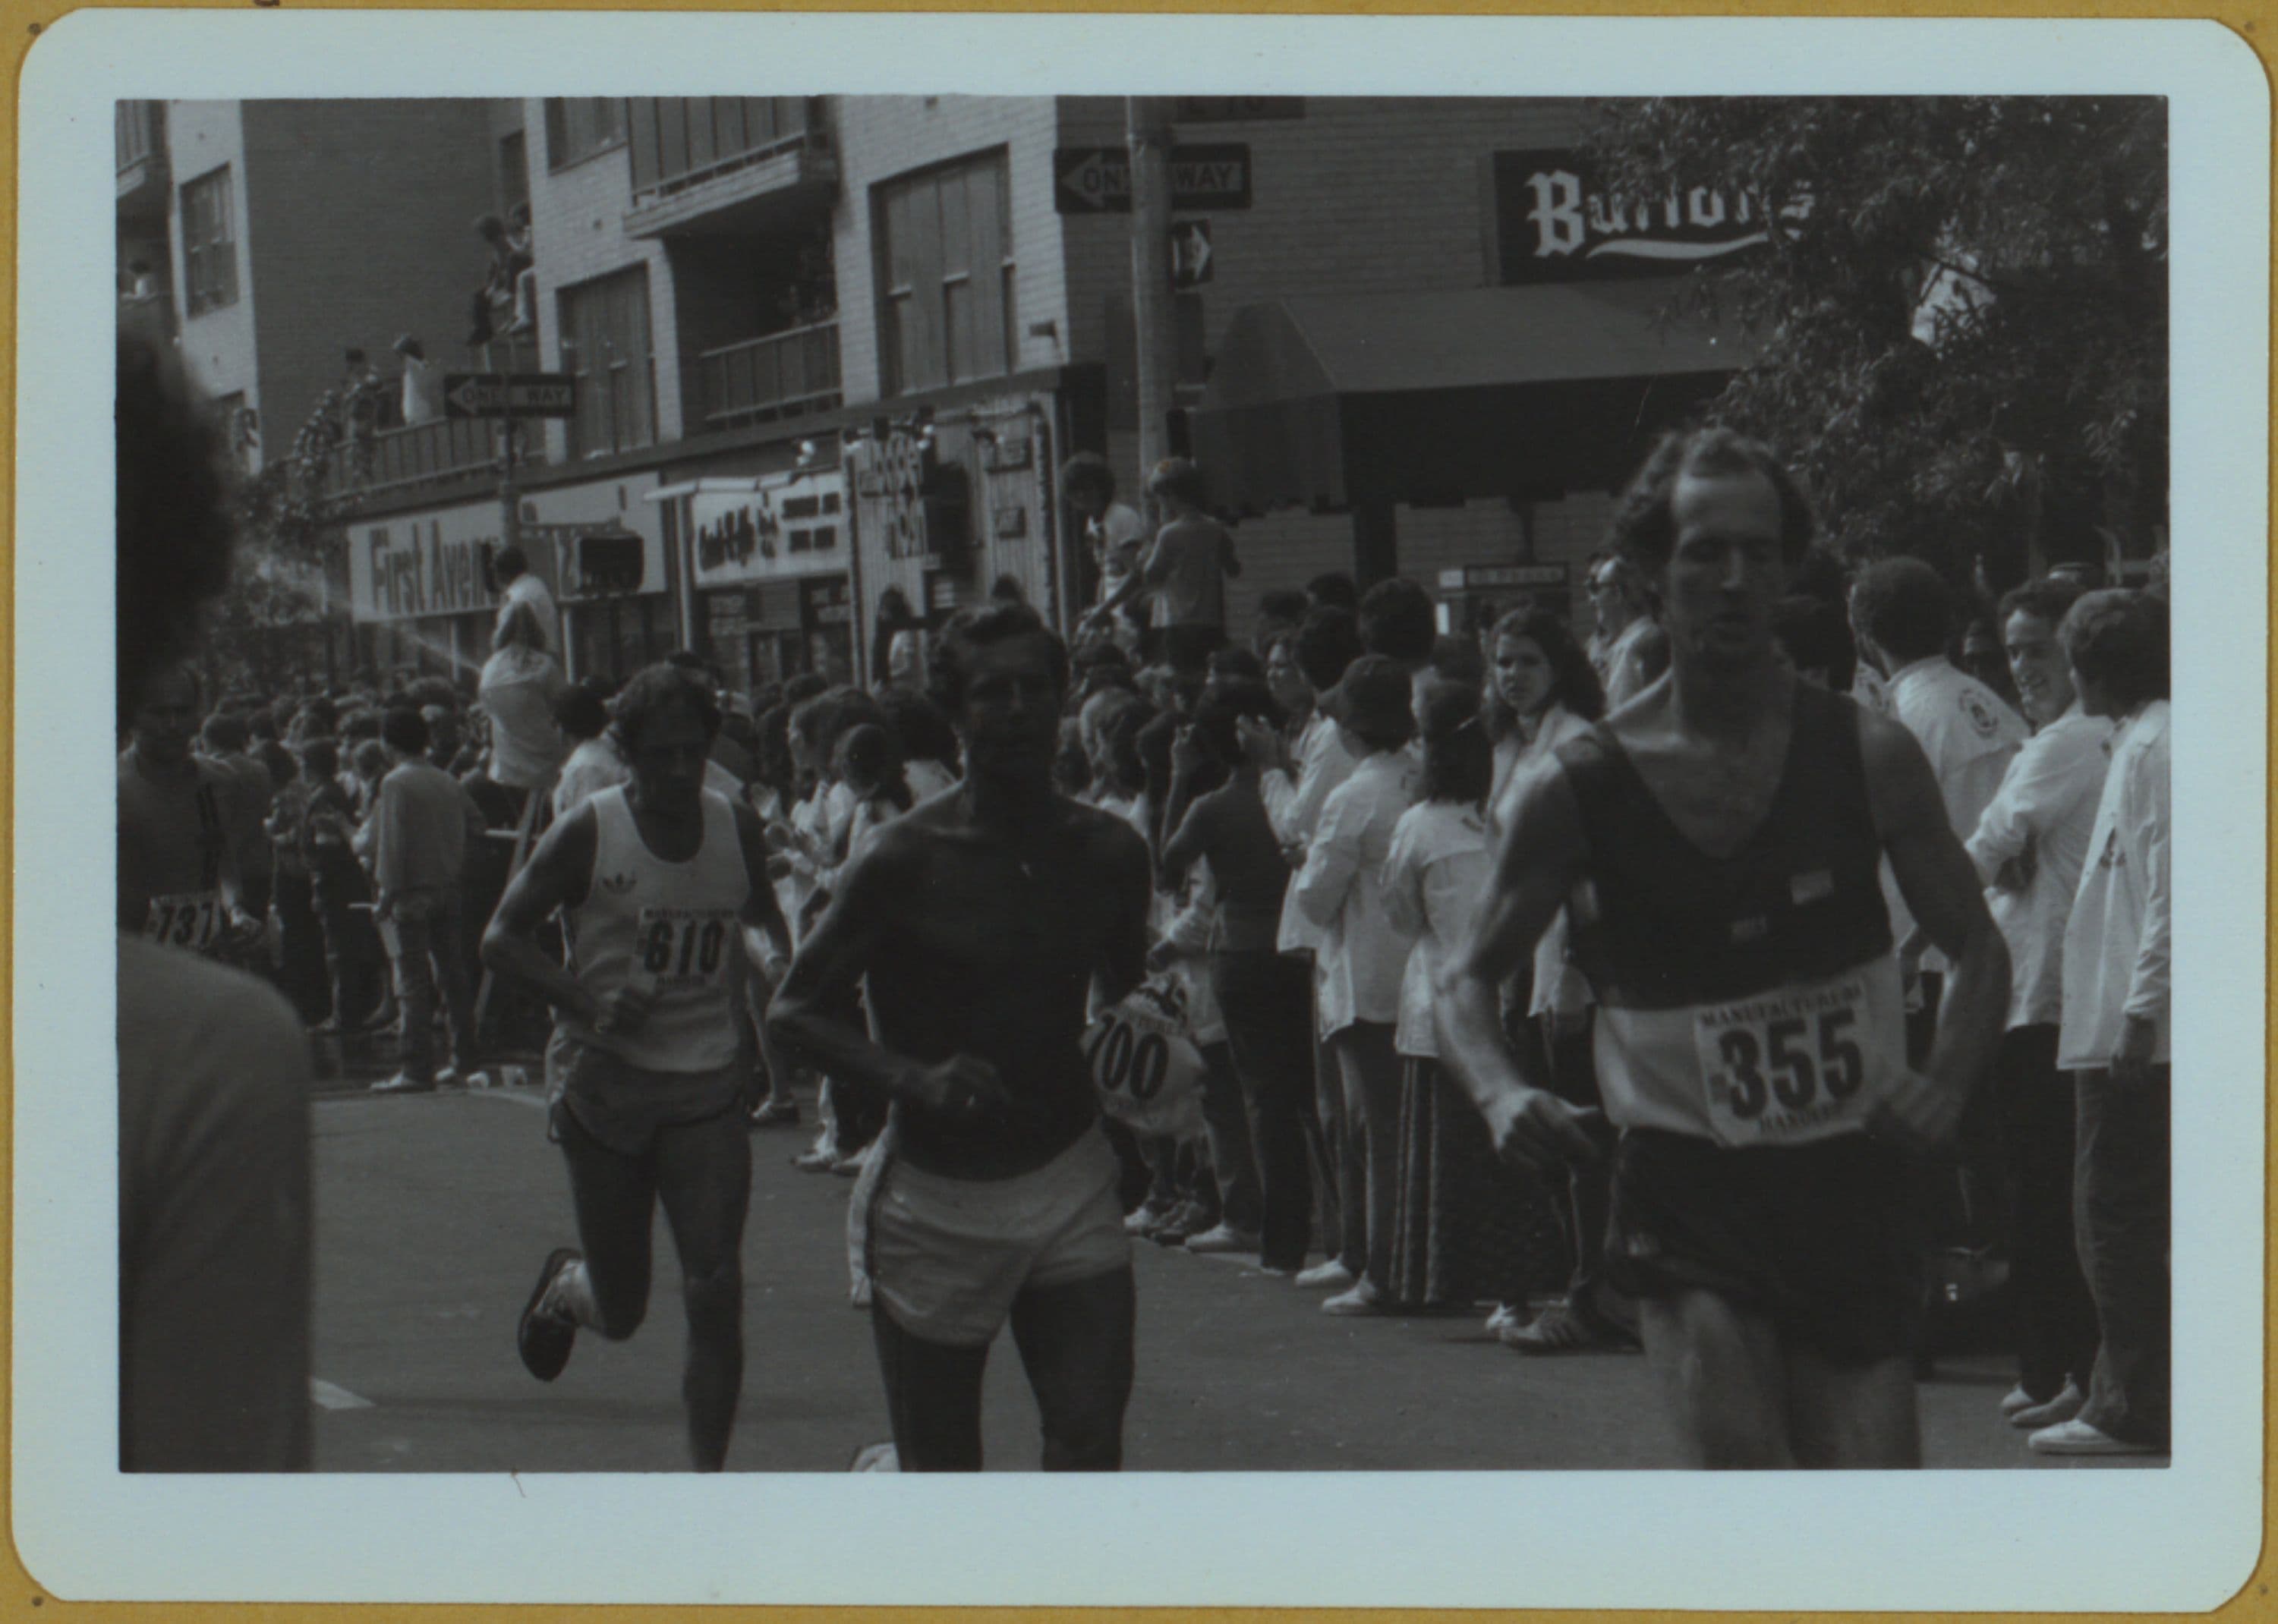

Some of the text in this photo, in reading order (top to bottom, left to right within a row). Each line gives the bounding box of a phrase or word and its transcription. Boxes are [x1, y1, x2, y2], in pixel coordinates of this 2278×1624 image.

[1174, 164, 1233, 190] WAY
[527, 387, 566, 407] WAY
[369, 521, 424, 613] First
[155, 902, 214, 945] 737
[644, 920, 725, 974] 610
[1718, 1008, 1864, 1119] 355
